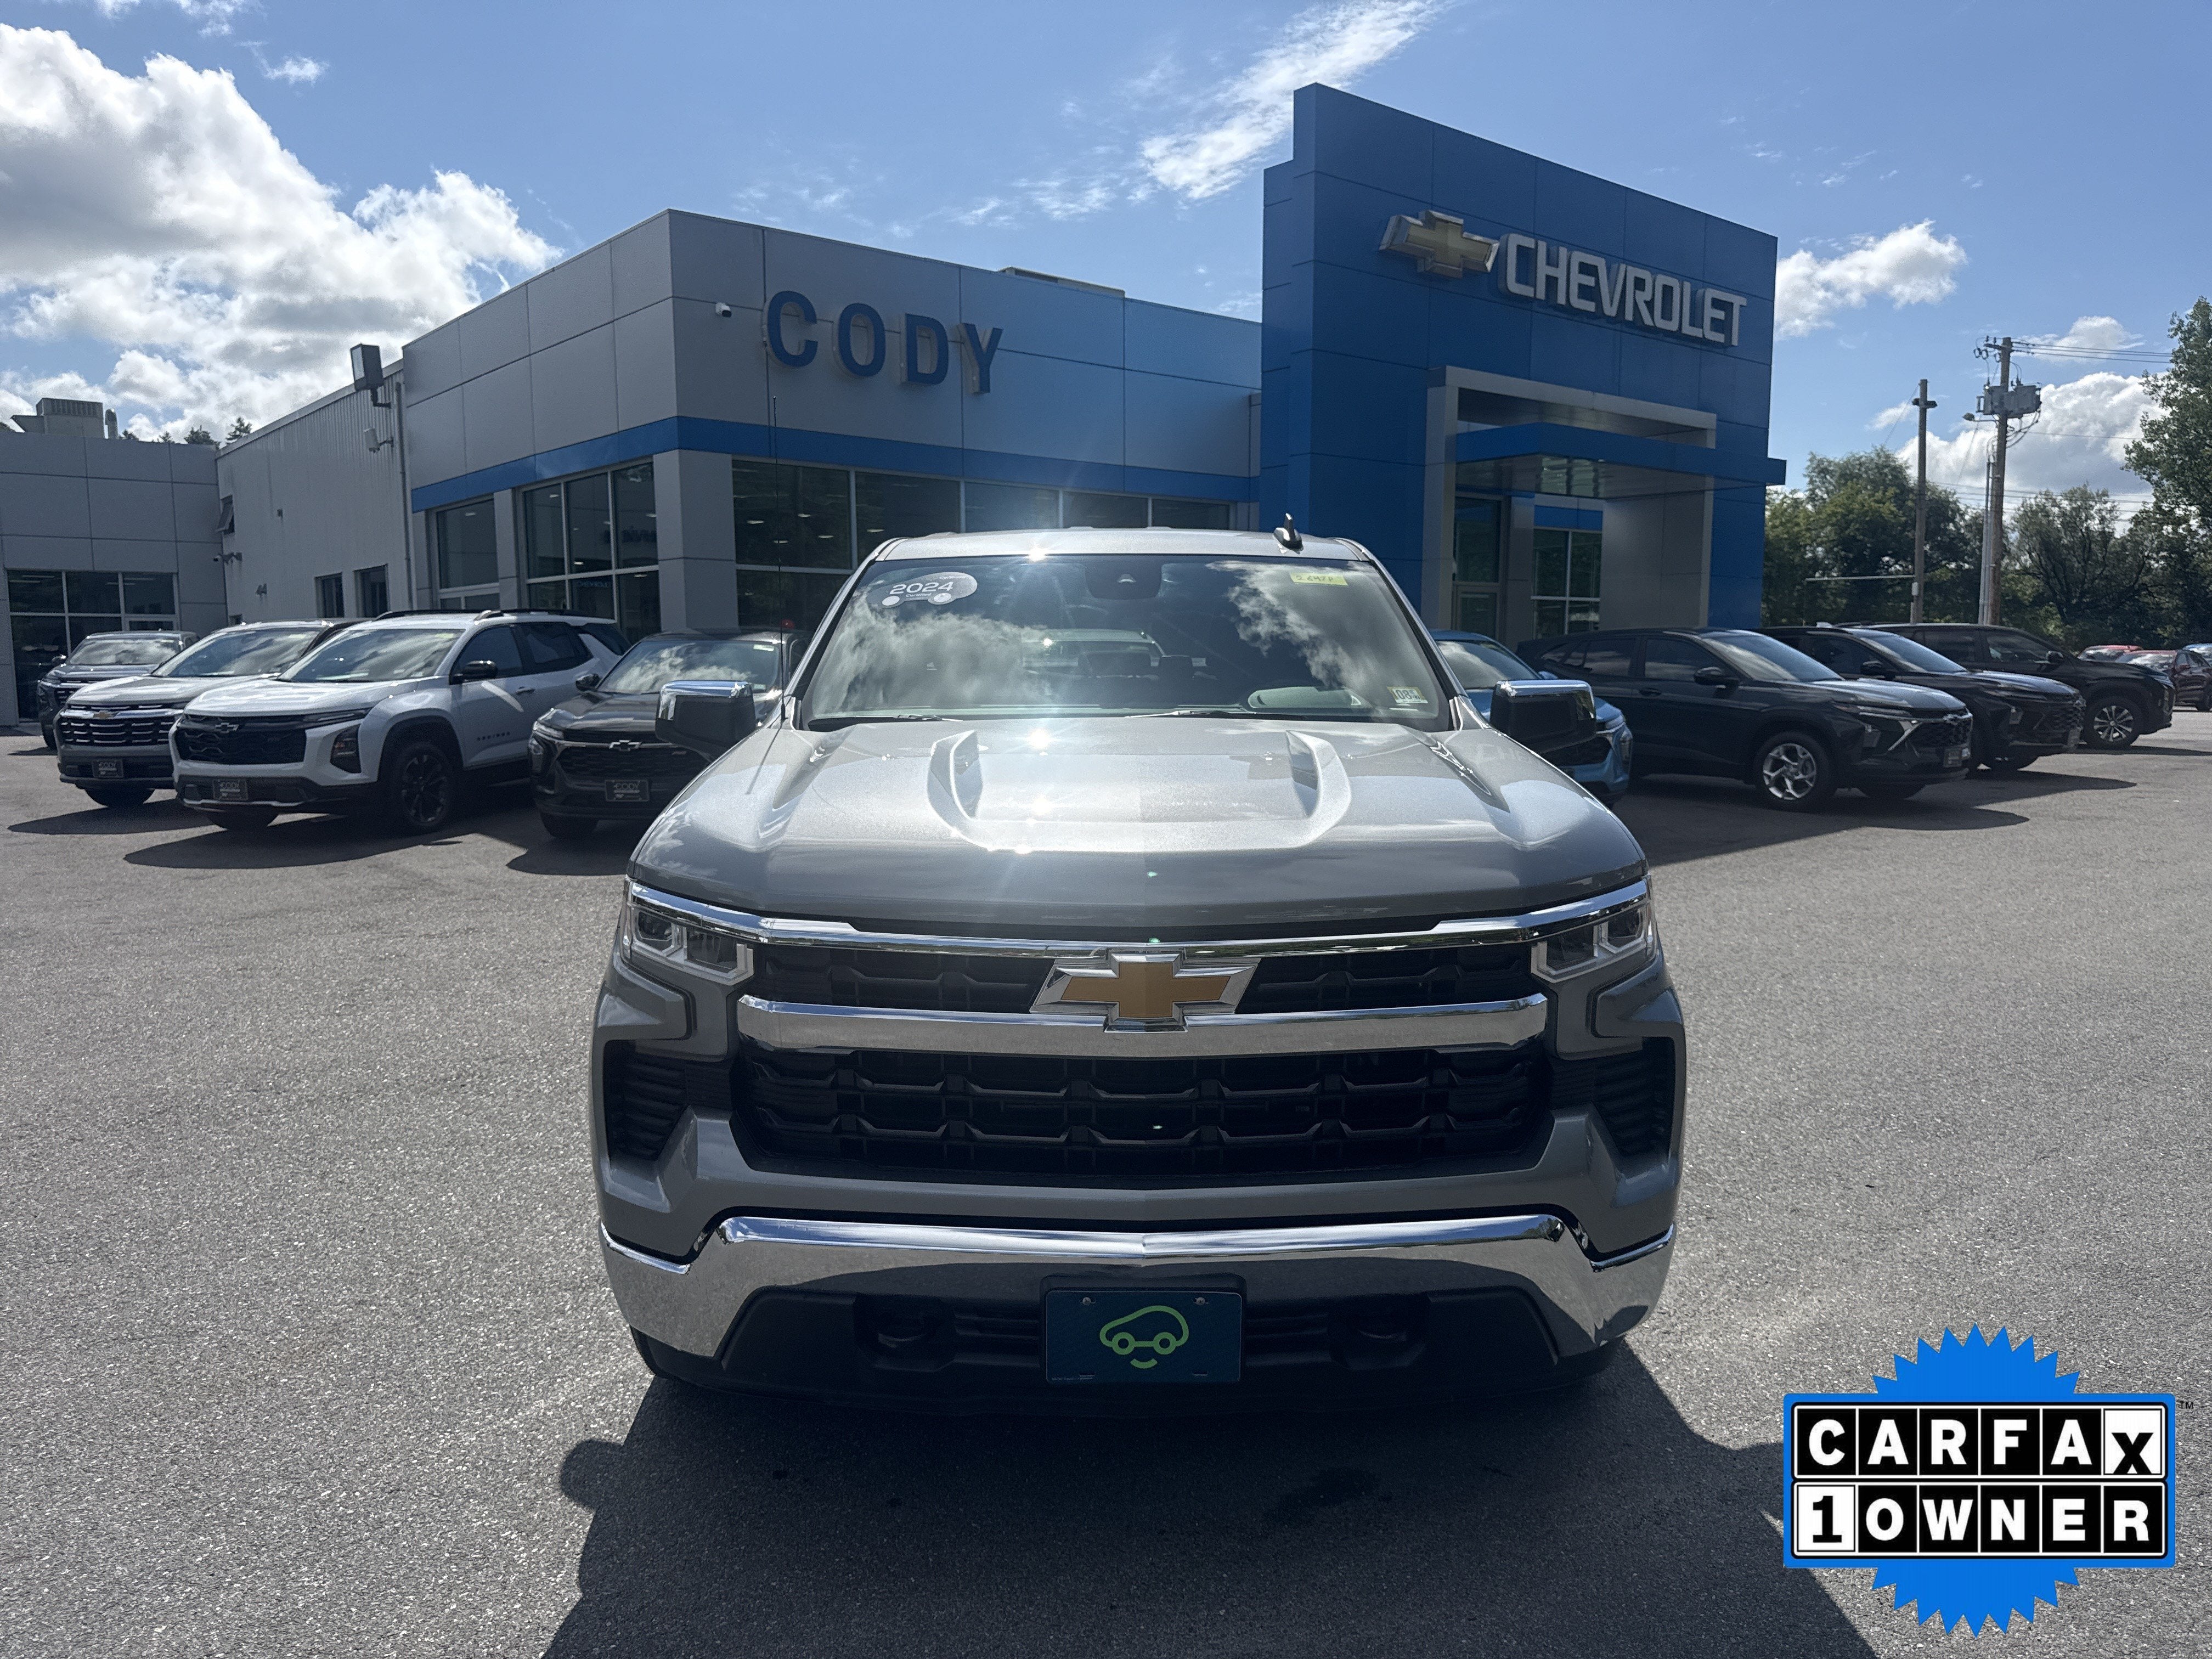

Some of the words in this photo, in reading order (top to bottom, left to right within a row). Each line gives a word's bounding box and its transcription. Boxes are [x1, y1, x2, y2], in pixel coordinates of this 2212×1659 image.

[1503, 233, 1747, 346] CHEVROLET
[765, 290, 1004, 394] CODY
[890, 582, 954, 595] 2024
[1395, 690, 1413, 699] 08
